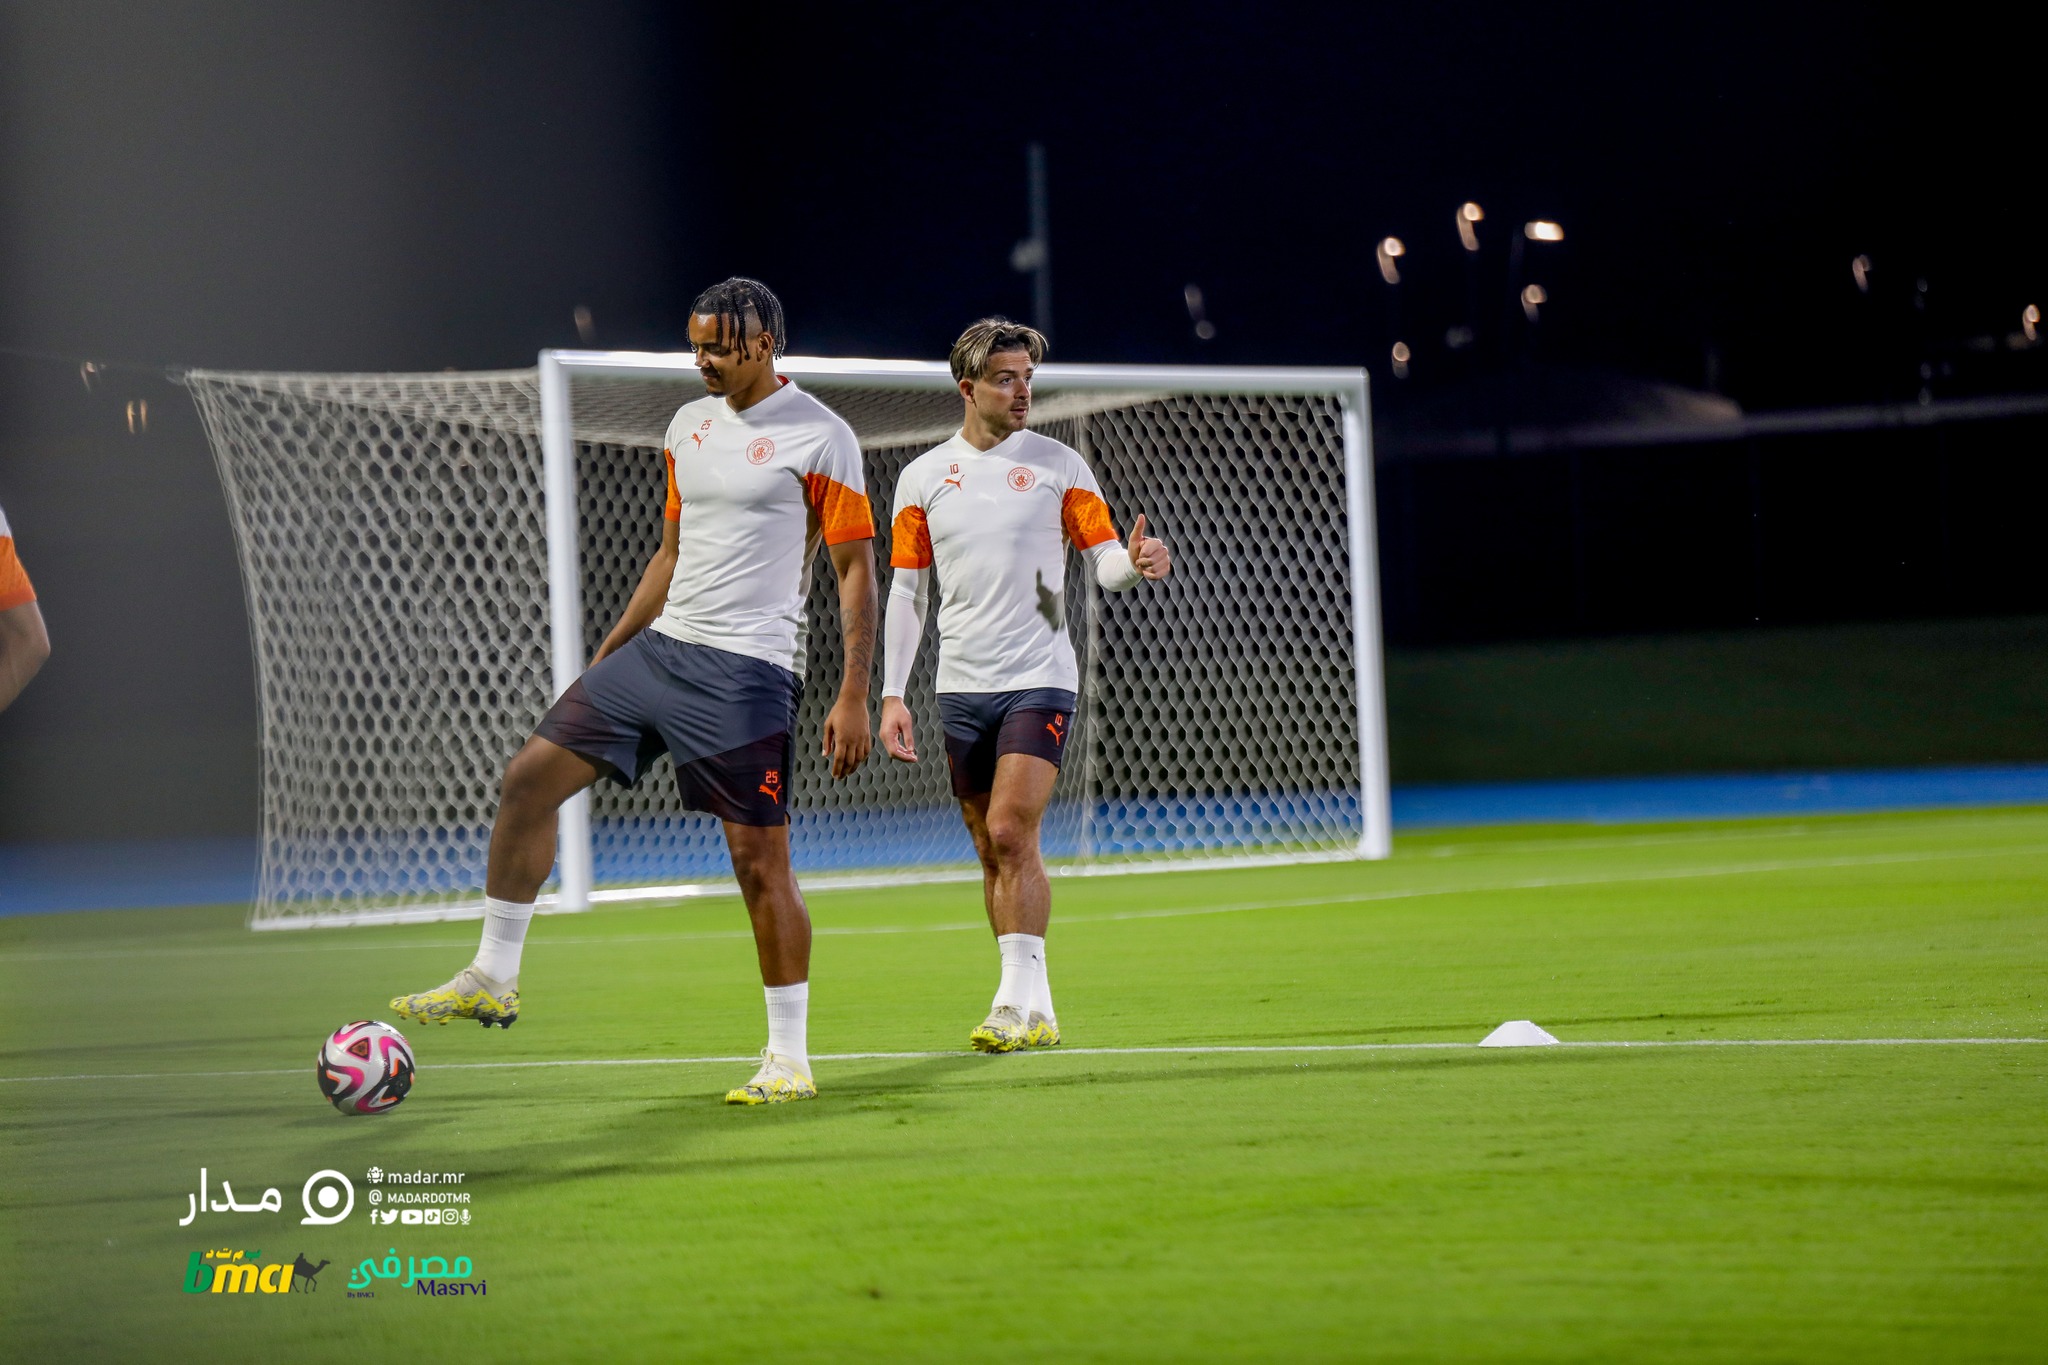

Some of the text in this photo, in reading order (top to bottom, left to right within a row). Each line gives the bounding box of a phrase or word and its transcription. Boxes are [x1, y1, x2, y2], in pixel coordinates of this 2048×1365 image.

[700, 418, 713, 431] 25
[949, 463, 960, 475] 10
[765, 770, 779, 784] 25
